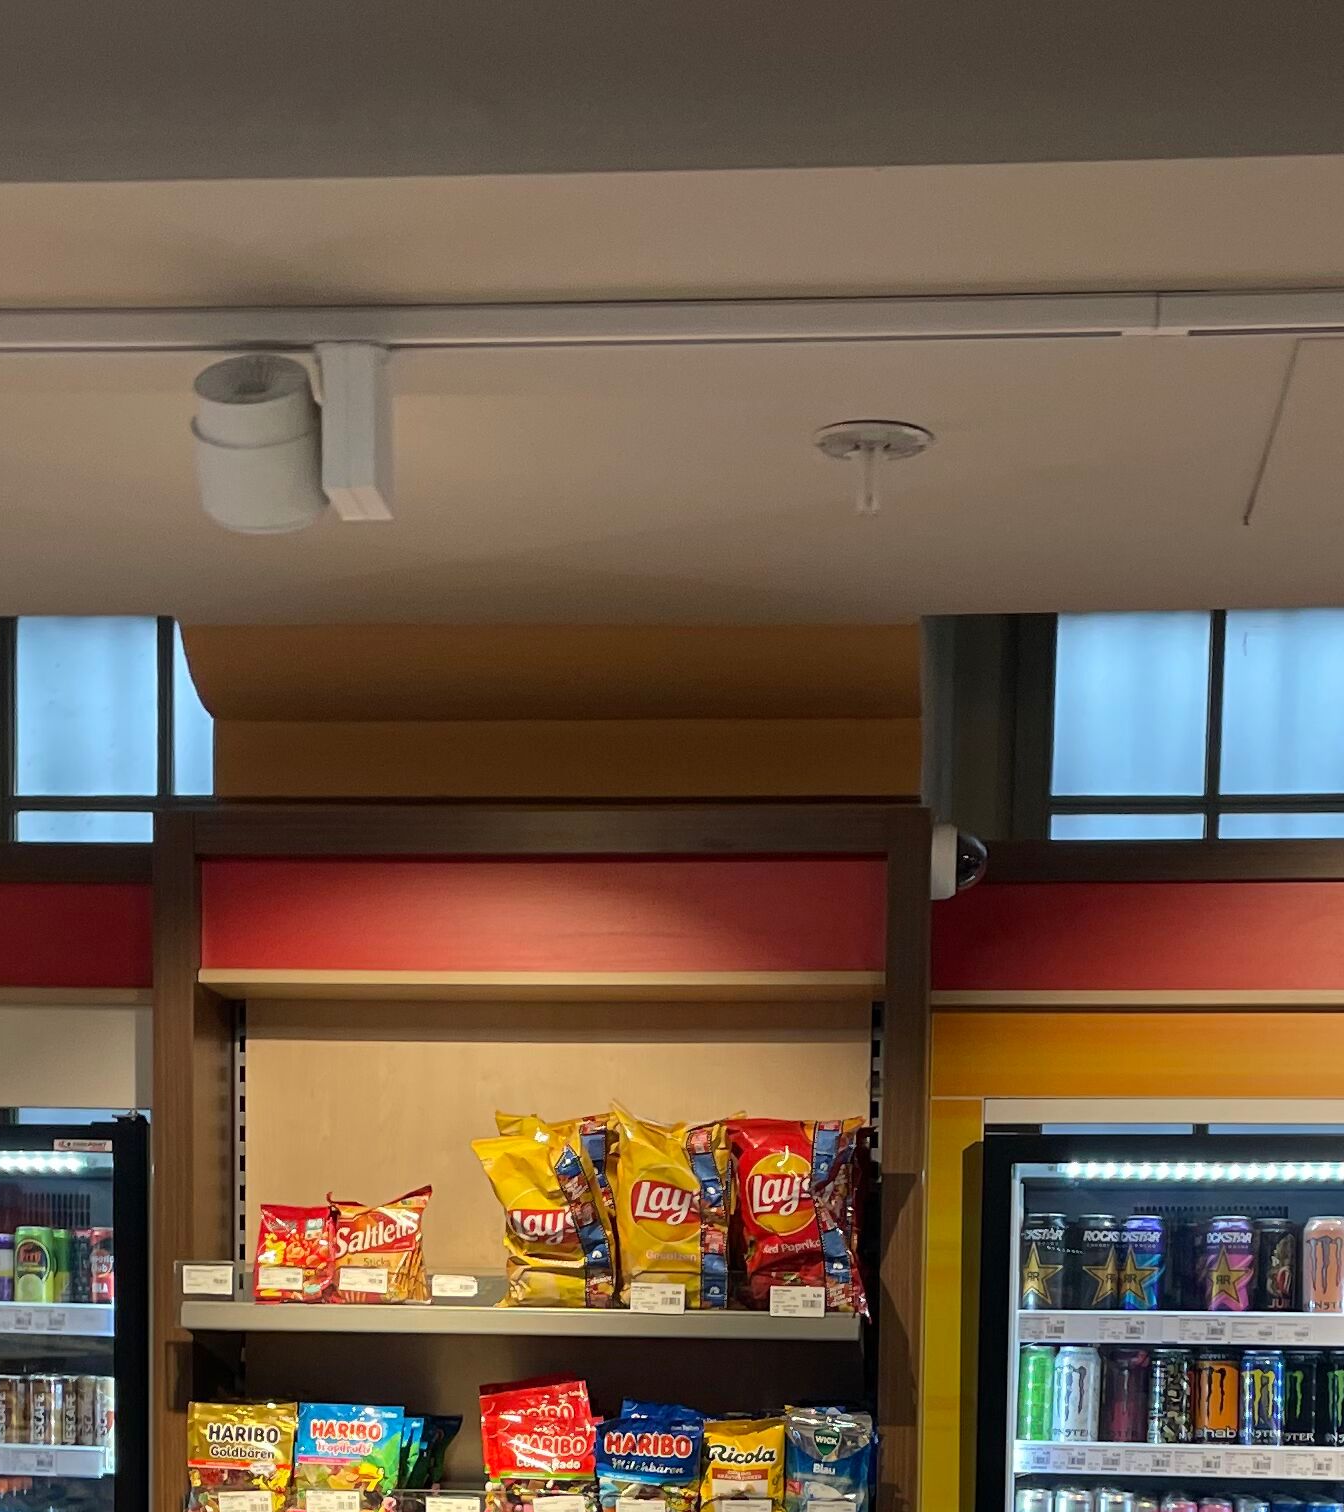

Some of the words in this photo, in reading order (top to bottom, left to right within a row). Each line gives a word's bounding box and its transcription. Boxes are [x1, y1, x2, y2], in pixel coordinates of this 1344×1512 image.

[1207, 1232, 1253, 1243] OCKSTAR
[207, 1423, 280, 1444] HARIBO
[311, 1419, 383, 1442] HARIBO
[605, 1430, 693, 1459] HARIBO
[814, 1436, 839, 1446] WICK
[210, 1445, 276, 1460] Goldbären
[706, 1443, 777, 1464] Ricola
[812, 1462, 837, 1475] Blau
